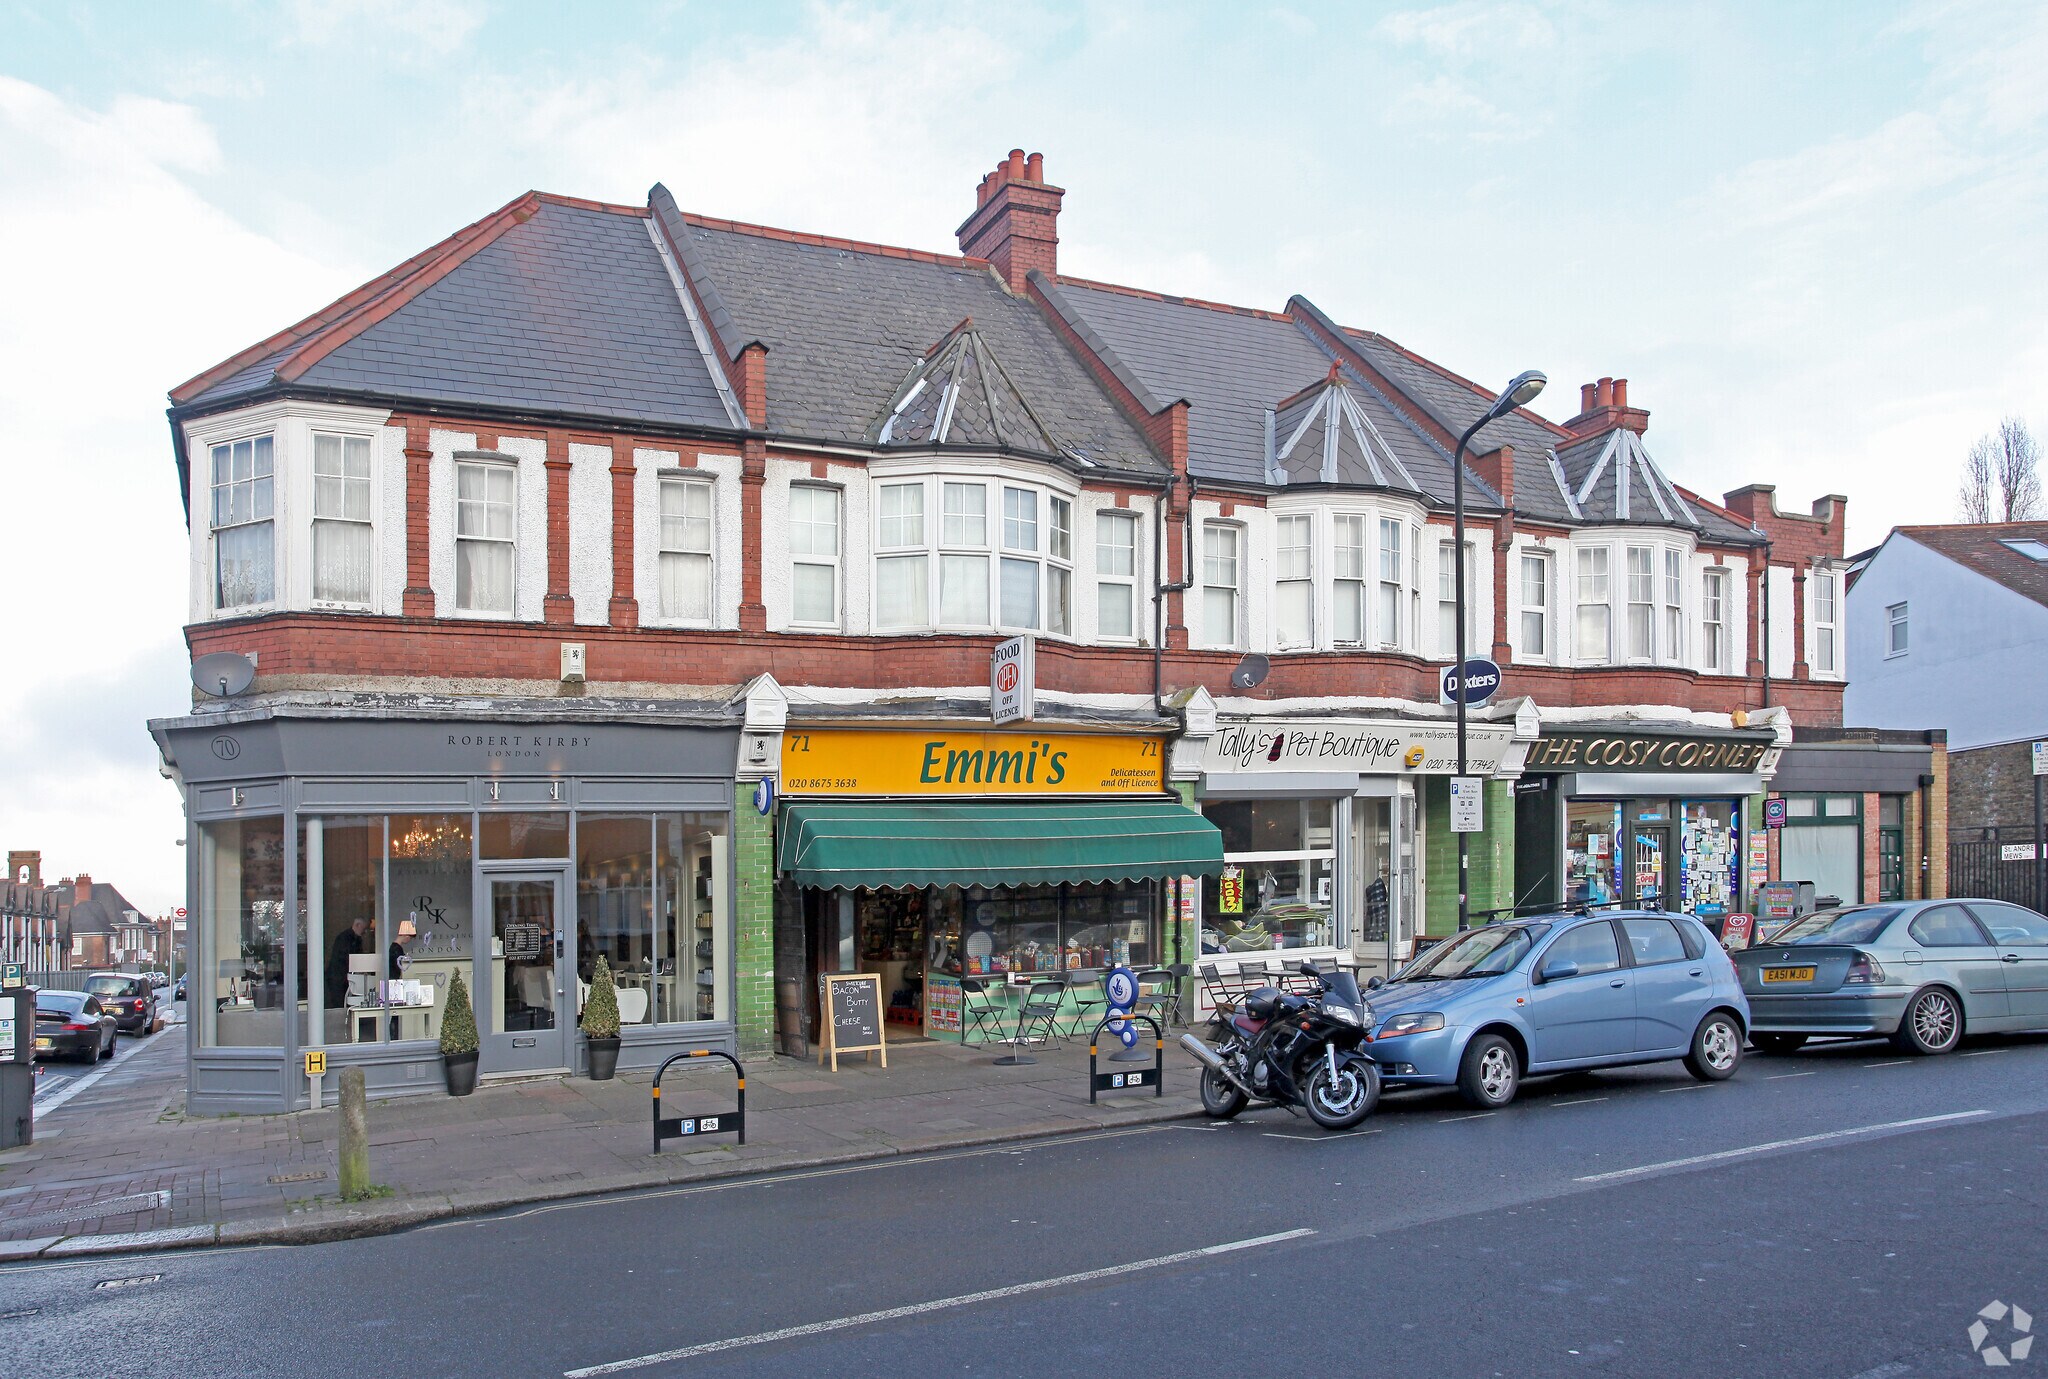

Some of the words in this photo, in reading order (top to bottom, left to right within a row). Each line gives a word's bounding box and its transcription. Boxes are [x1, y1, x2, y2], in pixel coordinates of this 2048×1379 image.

[996, 644, 1020, 663] FOOD
[998, 664, 1016, 690] OPEN
[1448, 674, 1496, 691] Dxters
[1002, 695, 1013, 705] OFF
[996, 706, 1018, 719] LICENCE
[448, 735, 521, 746] ROBERT
[534, 737, 590, 746] KIRBY
[791, 736, 810, 752] 71
[1216, 727, 1274, 767] Tally's
[1286, 730, 1319, 756] Pet
[1319, 731, 1400, 766] Boutique
[216, 740, 234, 756] 70
[1142, 742, 1156, 756] 71
[1526, 739, 1583, 765] THE
[1584, 739, 1660, 766] COSY
[1659, 741, 1764, 768] CORNER
[920, 740, 1068, 784] Emmi's
[1426, 760, 1444, 769] 020
[1446, 760, 1469, 769] 33
[1471, 760, 1494, 770] 7342
[1110, 768, 1156, 776] Delicatessen
[789, 779, 807, 788] 020
[810, 779, 832, 788] 8675
[835, 779, 857, 788] 3638
[1118, 779, 1130, 787] Off
[7, 966, 16, 977] P
[832, 983, 859, 995] BACON
[846, 996, 868, 1006] BUTTY
[834, 1015, 860, 1026] CHEESE
[309, 1054, 322, 1071] H
